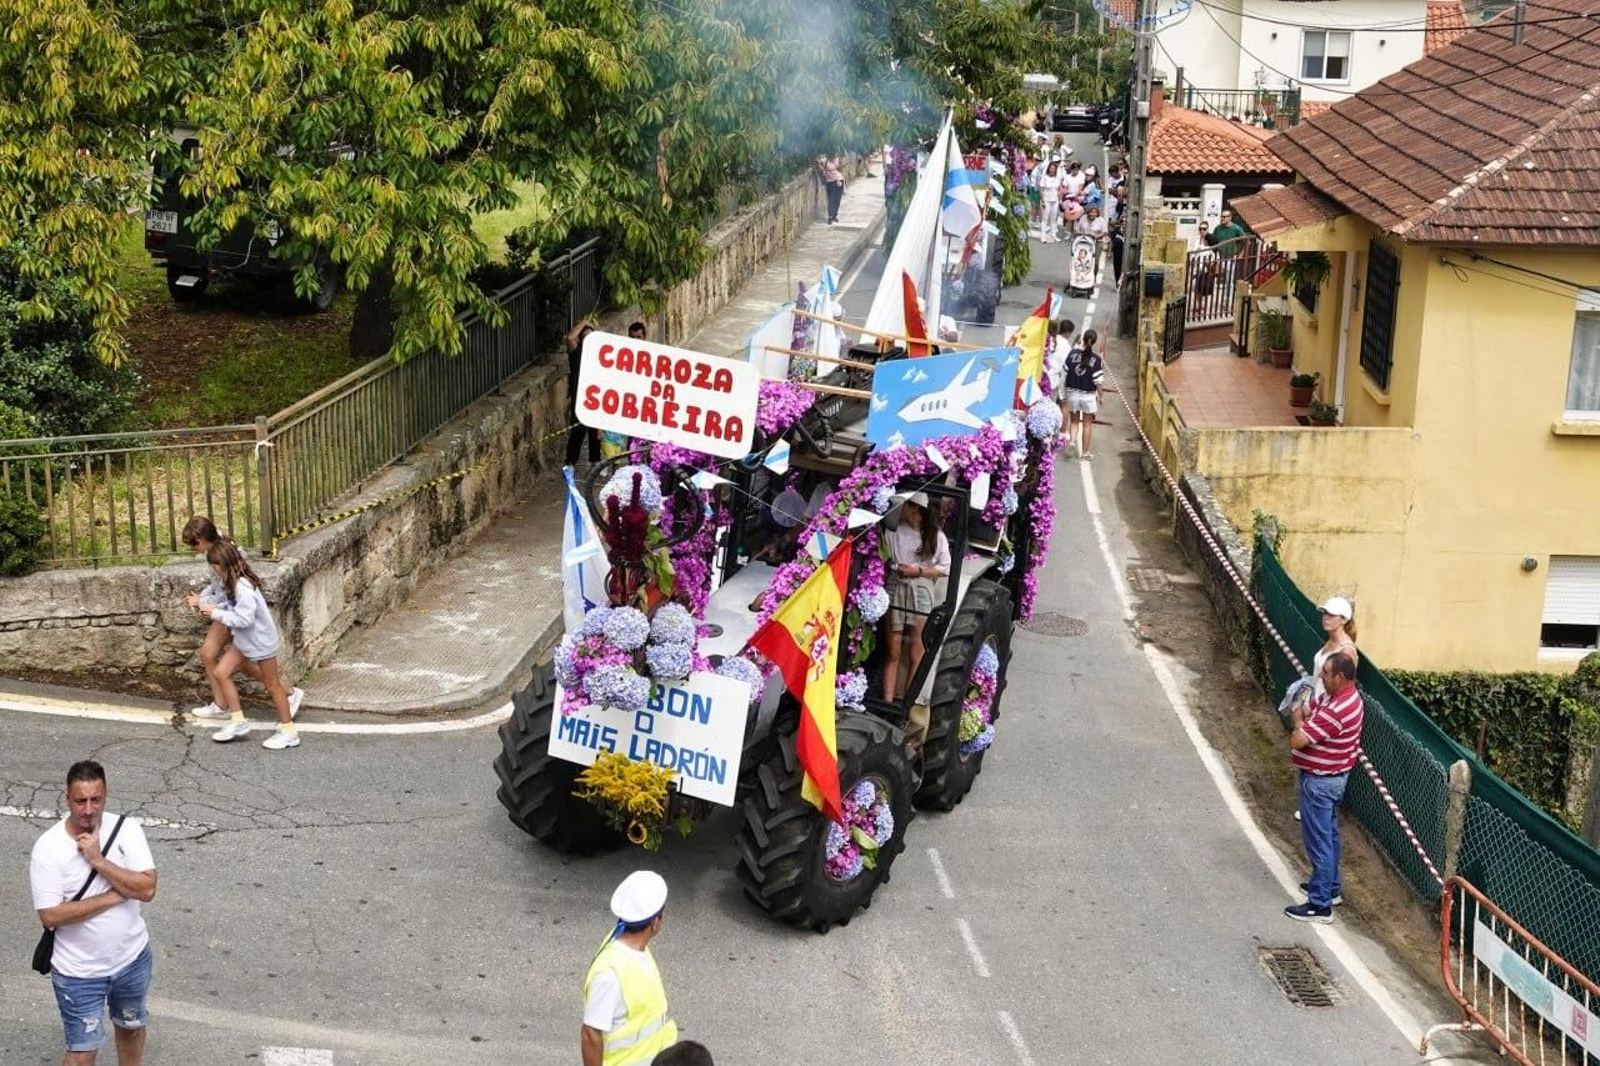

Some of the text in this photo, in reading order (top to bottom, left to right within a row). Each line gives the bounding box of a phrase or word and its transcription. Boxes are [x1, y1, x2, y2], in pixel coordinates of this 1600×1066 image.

[598, 344, 733, 394] CARROZA
[650, 380, 675, 401] DA
[583, 384, 743, 443] SOBREIRA
[634, 710, 655, 734] O
[628, 734, 727, 785] LADRÓN
